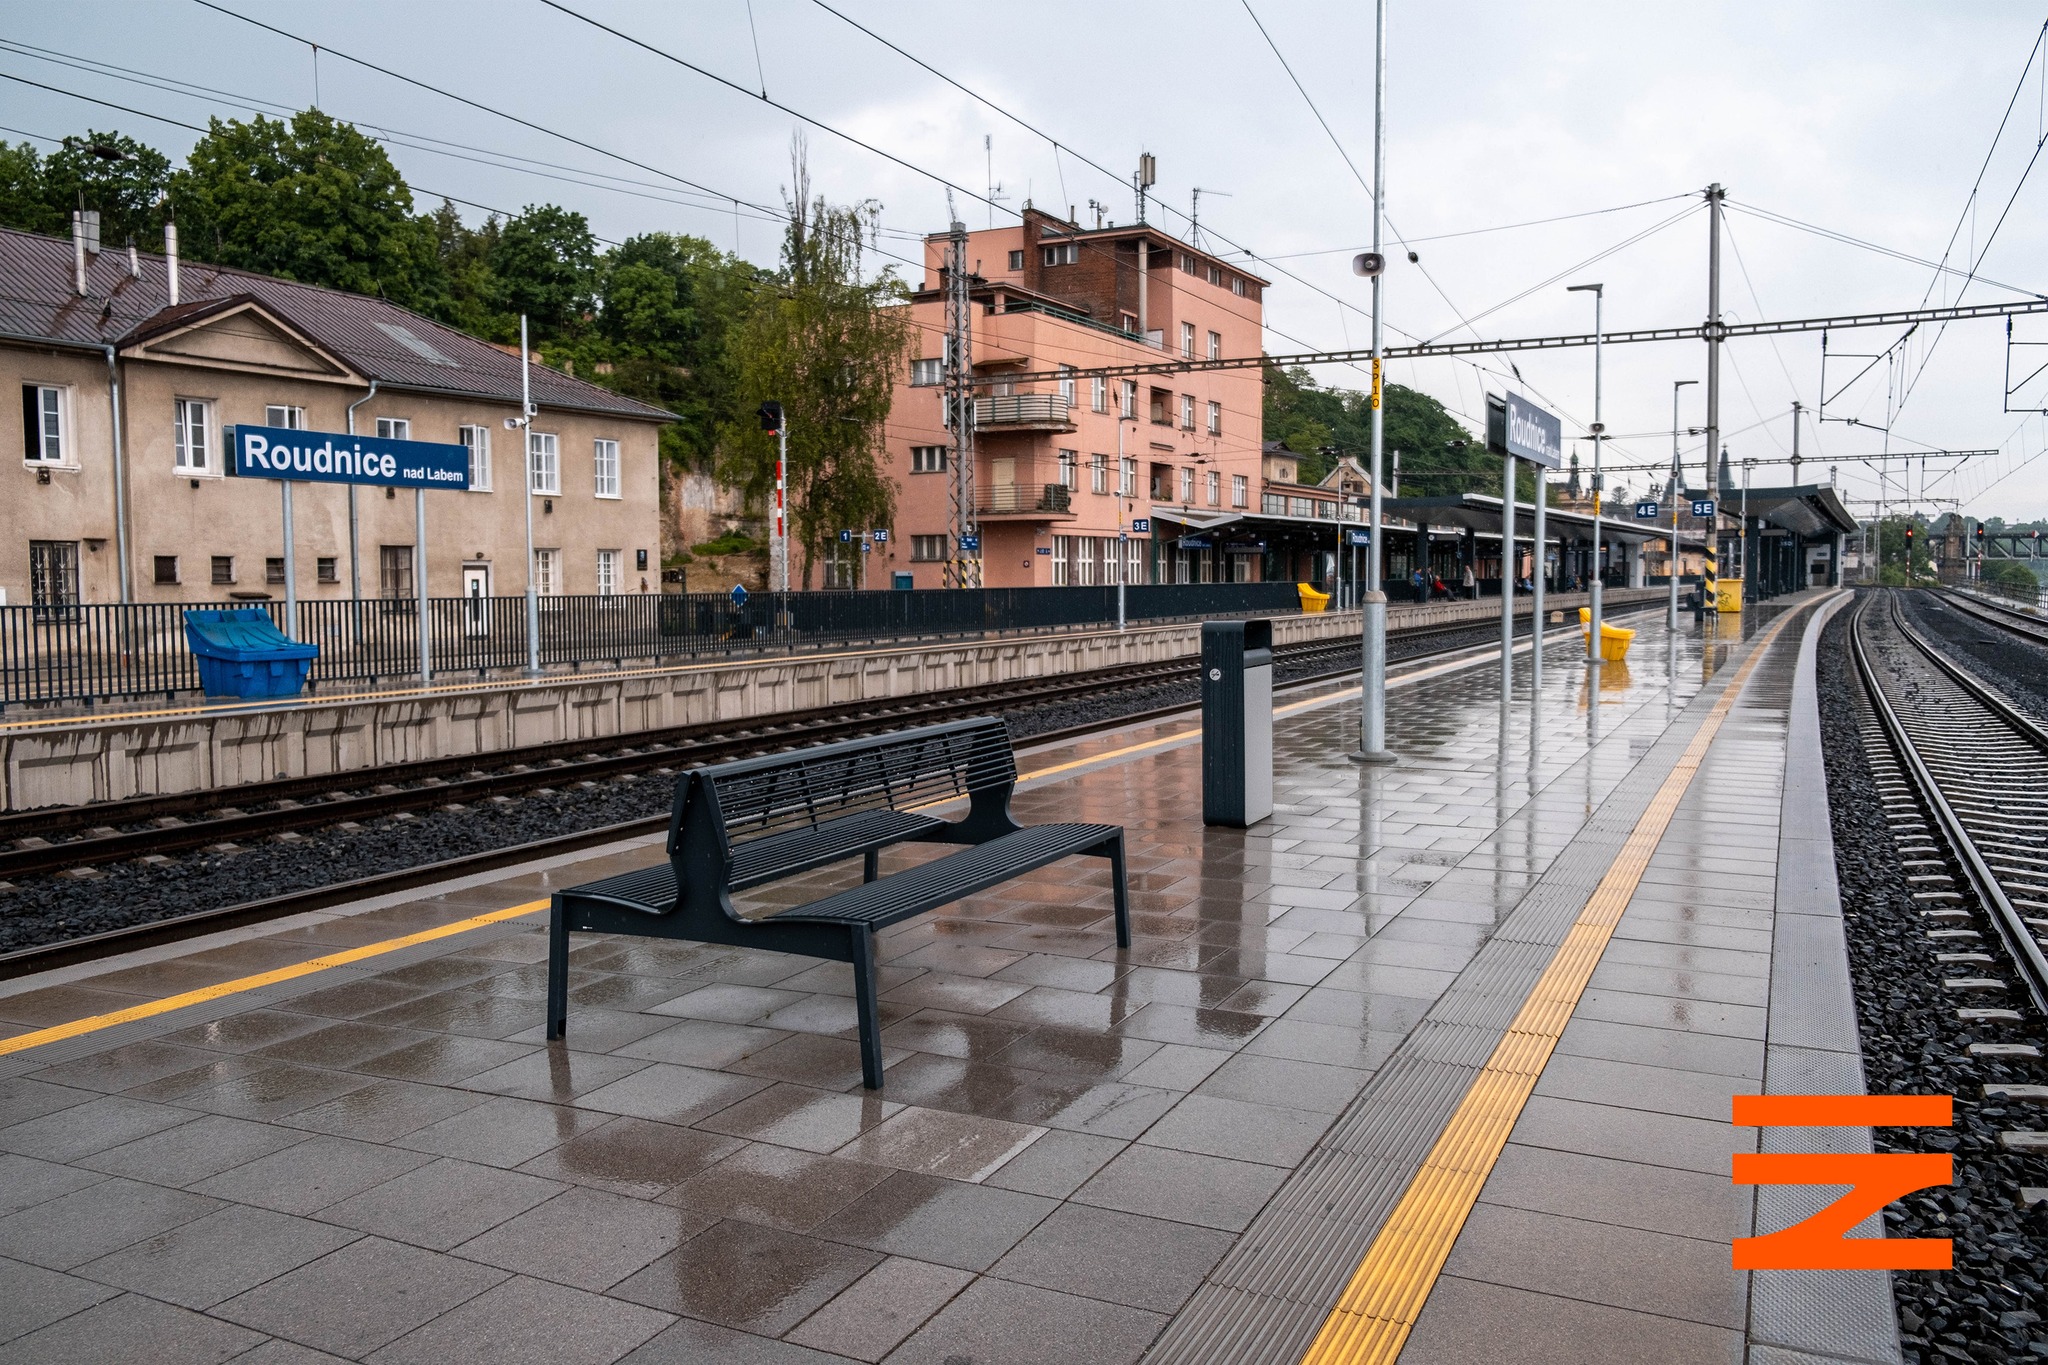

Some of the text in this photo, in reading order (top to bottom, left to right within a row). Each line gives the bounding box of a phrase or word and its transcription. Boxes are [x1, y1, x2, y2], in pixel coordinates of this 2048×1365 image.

[1372, 359, 1380, 408] SP10
[1509, 403, 1546, 454] Roudnice
[244, 433, 464, 482] Roudnice nad Labem
[842, 532, 848, 541] 1
